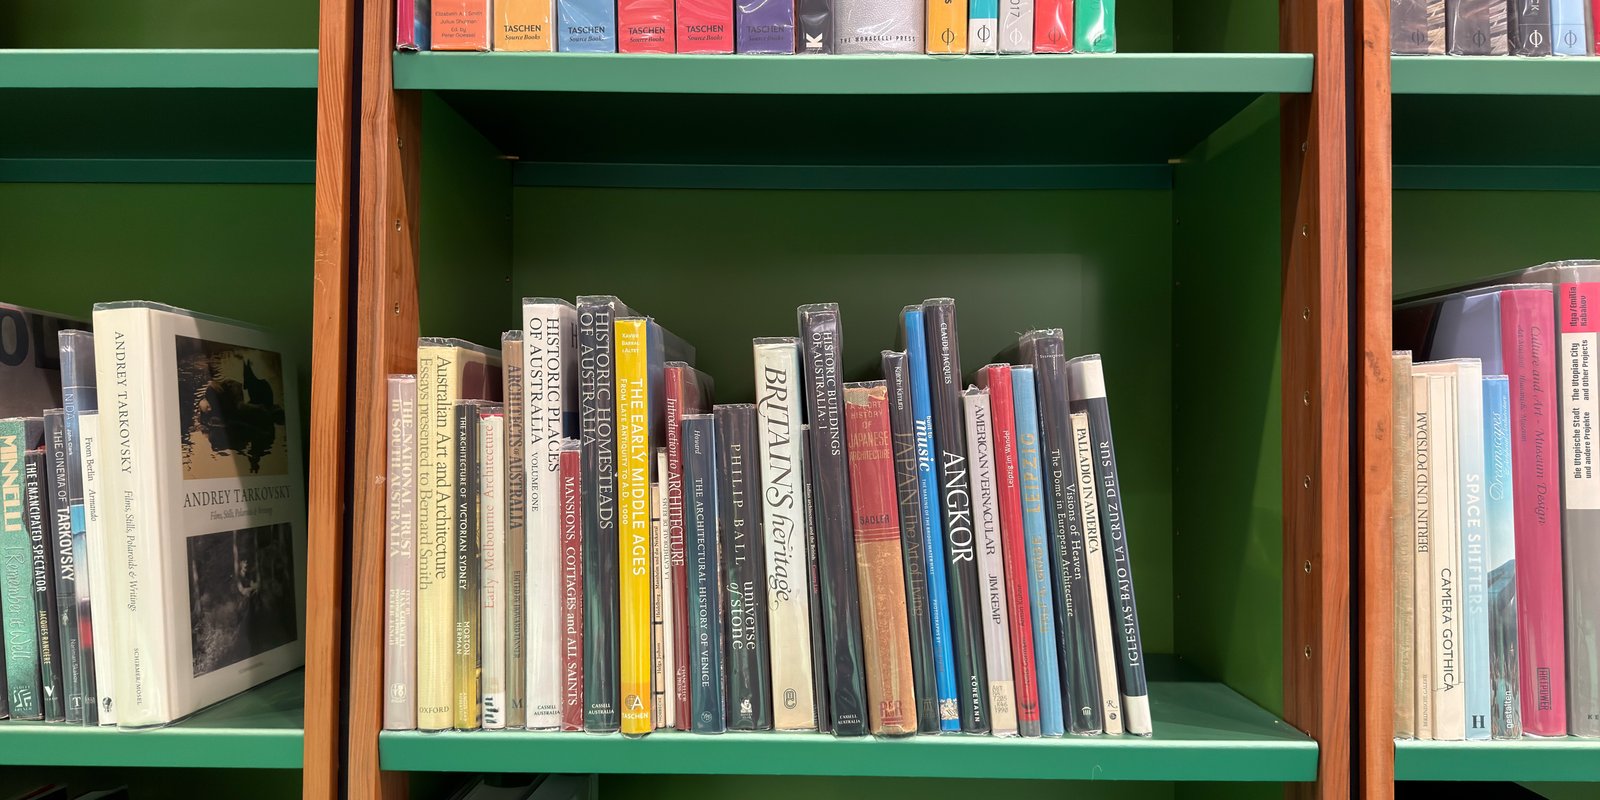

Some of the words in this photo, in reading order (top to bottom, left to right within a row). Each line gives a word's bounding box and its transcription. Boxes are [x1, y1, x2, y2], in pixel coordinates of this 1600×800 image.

[504, 25, 541, 33] TASCHEN
[628, 27, 665, 35] TASCHEN
[686, 25, 723, 33] TASCHEN
[530, 317, 543, 341] OF
[580, 312, 594, 337] OF
[115, 331, 127, 386] ANDREY
[546, 317, 560, 402] HISTORIC
[595, 311, 611, 401] HISTORIC
[823, 332, 836, 387] HISTORIC
[1570, 342, 1580, 357] City
[418, 358, 433, 400] Essays
[437, 355, 452, 428] Australian
[814, 351, 826, 421] AUSTRALIA:
[1571, 359, 1580, 387] Utopian
[1582, 369, 1590, 387] Other
[508, 365, 522, 447] ARCHITECTS
[530, 344, 543, 444] AUSTRALIA
[581, 344, 596, 447] AUSTRALIA
[630, 378, 644, 409] THE
[896, 388, 904, 410] Kimura
[1572, 389, 1580, 401] The
[117, 391, 133, 474] TARKOVSKY
[402, 399, 414, 428] THE
[667, 398, 677, 457] Introduction
[827, 390, 841, 456] BUILDINGS
[1572, 408, 1580, 428] Stadt
[1583, 412, 1591, 440] Projekte
[53, 431, 63, 450] THE
[85, 437, 93, 458] From
[391, 418, 402, 467] SOUTH
[419, 403, 433, 467] presented
[437, 433, 452, 458] Art
[547, 407, 560, 472] PLACES
[631, 414, 647, 463] EARLY
[694, 430, 702, 454] Howard
[758, 365, 794, 509] BRITAIN'S
[848, 431, 889, 448] JAPANESE
[916, 419, 934, 472] music
[975, 404, 989, 468] AMERICAN
[1099, 441, 1112, 467] SUR
[1416, 412, 1428, 471] POTSDAM
[1572, 429, 1582, 466] Utopische
[1584, 441, 1592, 465] andere
[26, 462, 37, 478] THE
[55, 451, 66, 488] CINEMA
[86, 459, 95, 481] Berlin
[402, 433, 413, 508] NATIONAL
[436, 462, 452, 488] and
[483, 425, 495, 499] Architecture
[531, 452, 539, 491] VOLUME
[596, 408, 613, 530] HOMESTEADS
[622, 469, 628, 480] TO
[670, 459, 678, 469] to
[730, 444, 744, 508] PHILIP
[1020, 433, 1041, 513] LEIPZIG
[1051, 448, 1061, 467] The
[1573, 467, 1582, 479] Die
[1584, 466, 1592, 479] und
[58, 490, 68, 502] OF
[183, 489, 231, 508] ANDREY
[234, 485, 292, 503] TARKOVSKY
[420, 472, 432, 486] to
[460, 487, 467, 498] OF
[509, 456, 523, 530] AUSTRALIA
[632, 468, 645, 529] MIDDLE
[695, 477, 704, 498] THE
[1053, 470, 1063, 497] Dome
[1076, 428, 1092, 484] PALLADIO
[1084, 500, 1098, 554] AMERICA
[1104, 472, 1116, 498] DEL
[1416, 474, 1428, 505] UND
[27, 482, 43, 542] EMANCIPATED
[88, 489, 98, 522] Armando
[124, 490, 133, 513] Films,
[390, 472, 401, 558] AUSTRALIA
[420, 488, 433, 545] Bernard
[531, 492, 539, 512] ONE
[564, 476, 576, 544] MANSIONS,
[668, 471, 684, 566] ARCHITECTURE
[942, 450, 974, 564] ANGKOR
[981, 471, 996, 555] VERNACULAR
[1056, 500, 1064, 509] in
[1066, 483, 1077, 522] Visions
[1466, 474, 1481, 528] SPACE
[401, 510, 412, 558] TRUST
[436, 491, 452, 579] Architecture
[459, 503, 468, 552] VICTORIAN
[484, 505, 495, 571] Melbourne
[663, 519, 668, 527] DE
[733, 518, 746, 565] BALL
[1057, 513, 1070, 556] European
[1070, 524, 1080, 536] of
[1108, 503, 1122, 541] CRUZ
[1418, 509, 1429, 553] BERLIN
[57, 506, 75, 581] TARKOVSKY
[126, 535, 138, 570] Polaroids
[633, 534, 646, 576] AGES
[696, 501, 706, 583] ARCHITECTURAL
[1071, 540, 1083, 580] Heaven
[1115, 546, 1125, 562] LA
[32, 545, 47, 592] SPECTATOR
[420, 548, 433, 590] Smith
[459, 555, 467, 590] SYDNEY
[565, 546, 577, 610] COTTAGES
[664, 571, 669, 580] LA
[768, 513, 794, 611] heritage
[1468, 534, 1483, 615] SHIFTERS
[126, 580, 138, 612] Writings
[726, 582, 743, 598] of
[988, 574, 998, 591] JIM
[1062, 559, 1074, 617] Architecture
[1117, 568, 1131, 601] BAJO
[1441, 568, 1453, 624] CAMERA
[39, 610, 48, 636] JACQUES
[567, 613, 577, 634] and
[699, 586, 708, 629] HISTORY
[730, 599, 745, 650] stone
[743, 581, 758, 650] universe
[990, 592, 1001, 624] KEMP
[567, 637, 577, 660] ALL
[701, 633, 708, 647] OF
[1121, 606, 1140, 667] IGLESIAS
[701, 650, 710, 687] VENICE
[1442, 628, 1454, 692] GOTHICA
[567, 662, 578, 706] SAINTS
[971, 676, 980, 722] KÖNEMANN
[419, 706, 450, 714] OXFORD
[1505, 690, 1514, 729] gestalten
